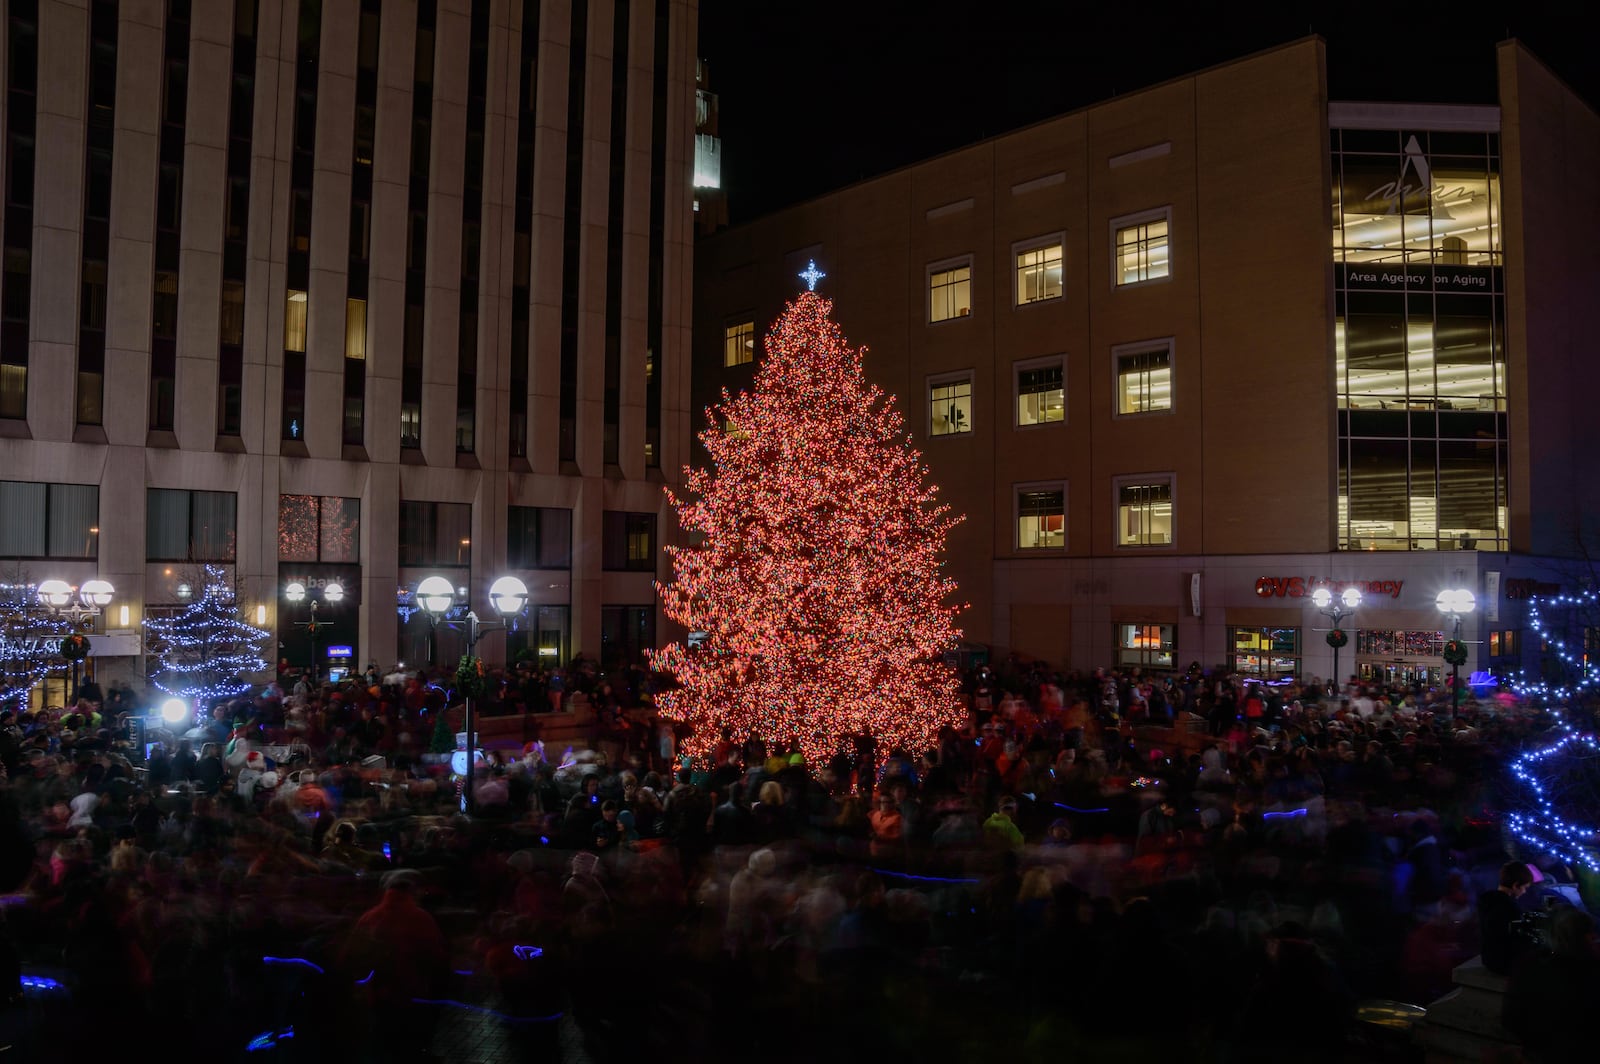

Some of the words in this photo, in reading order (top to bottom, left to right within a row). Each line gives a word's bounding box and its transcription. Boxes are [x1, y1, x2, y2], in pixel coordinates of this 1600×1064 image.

[1350, 272, 1377, 282] Area
[1381, 273, 1426, 285] Agency
[1434, 275, 1449, 284] on
[1453, 275, 1486, 286] Aging
